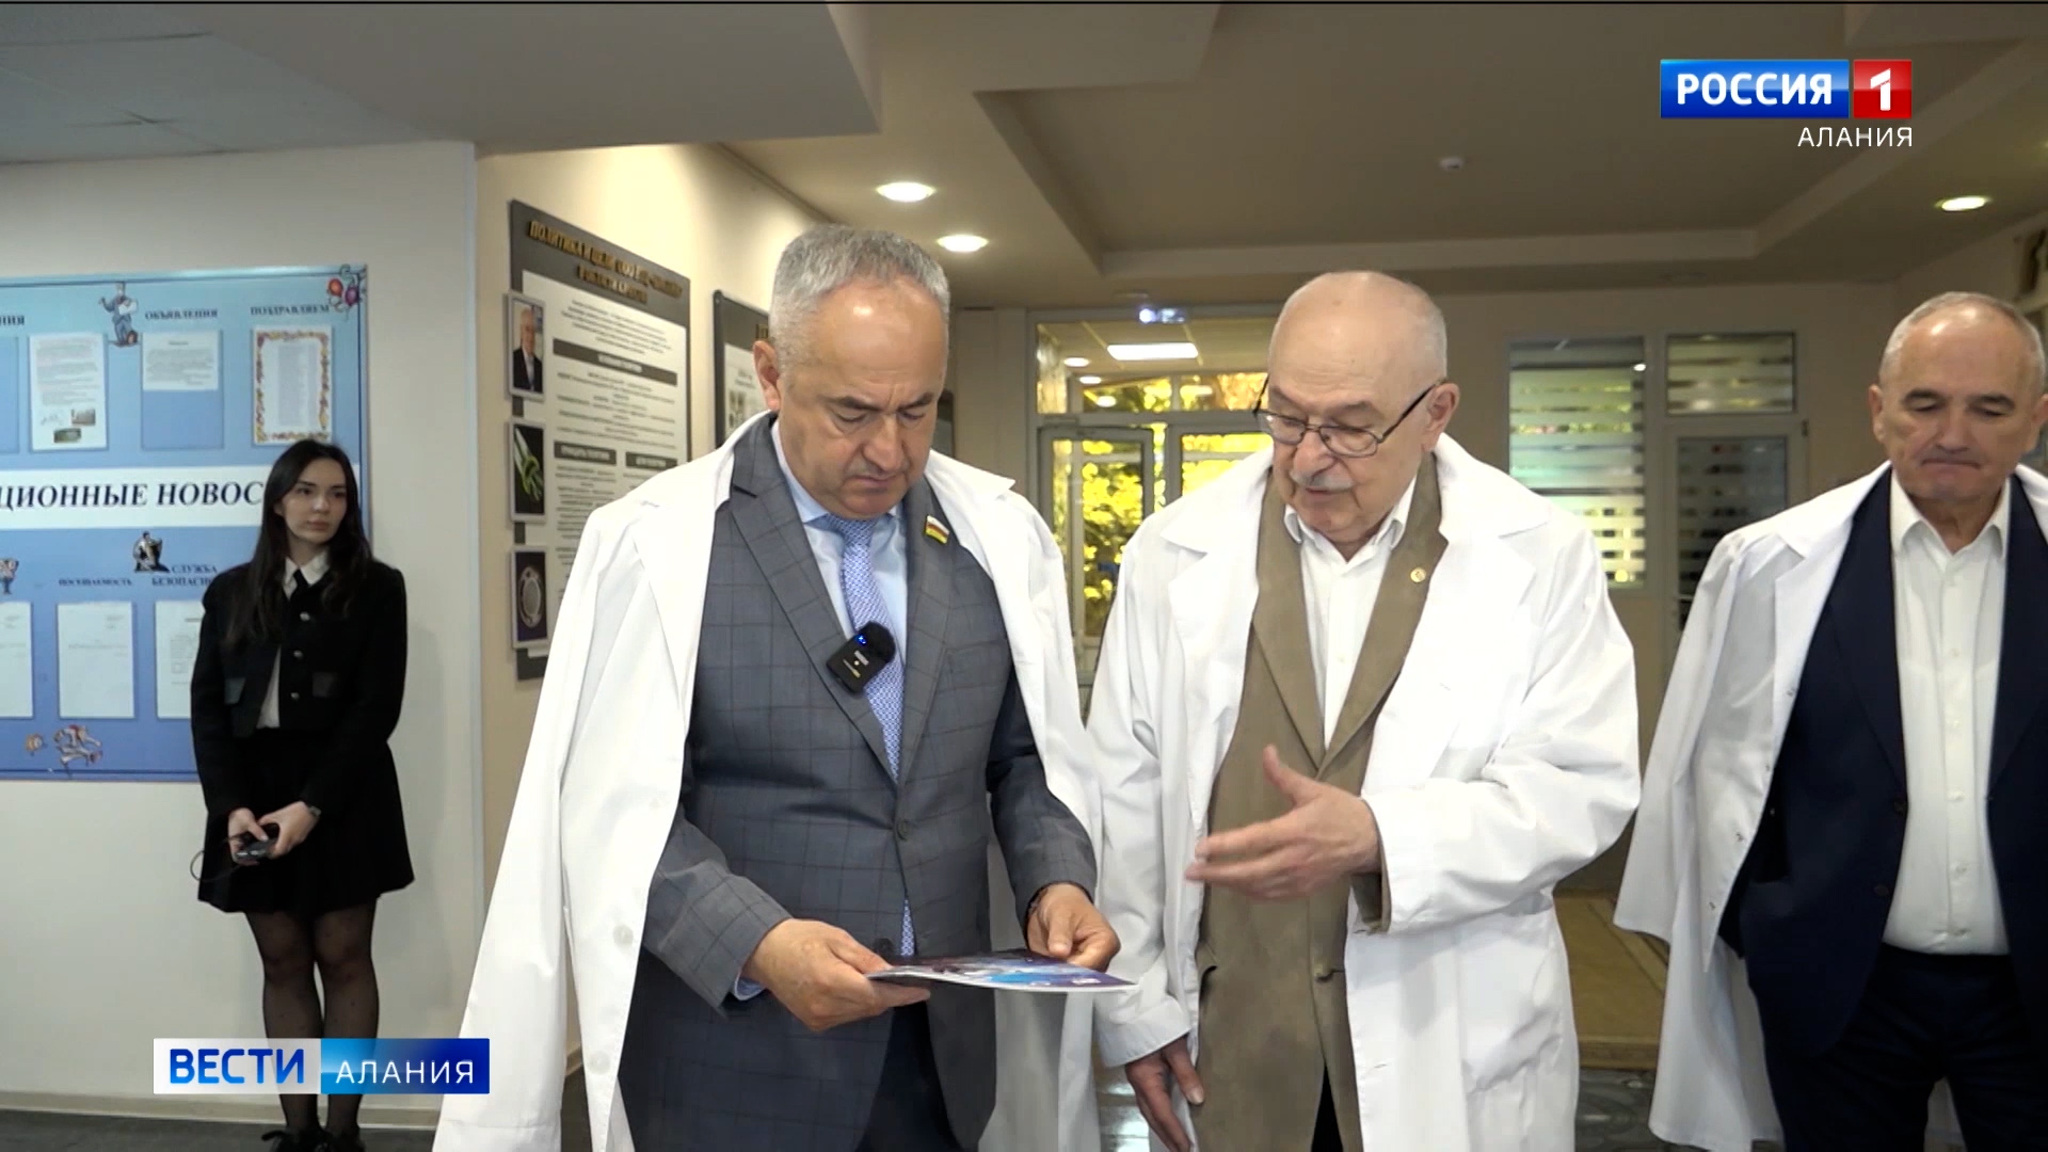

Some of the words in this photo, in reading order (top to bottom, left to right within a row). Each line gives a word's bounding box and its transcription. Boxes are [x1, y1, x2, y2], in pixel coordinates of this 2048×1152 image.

[144, 308, 218, 320] ОБЪЯВЛЕНИЯ
[250, 304, 331, 316] ПОЗДРАВЛЯЕМ
[171, 564, 218, 574] СЛУЖБА
[58, 577, 133, 587] ПОСЕЩАЕМОСТЬ
